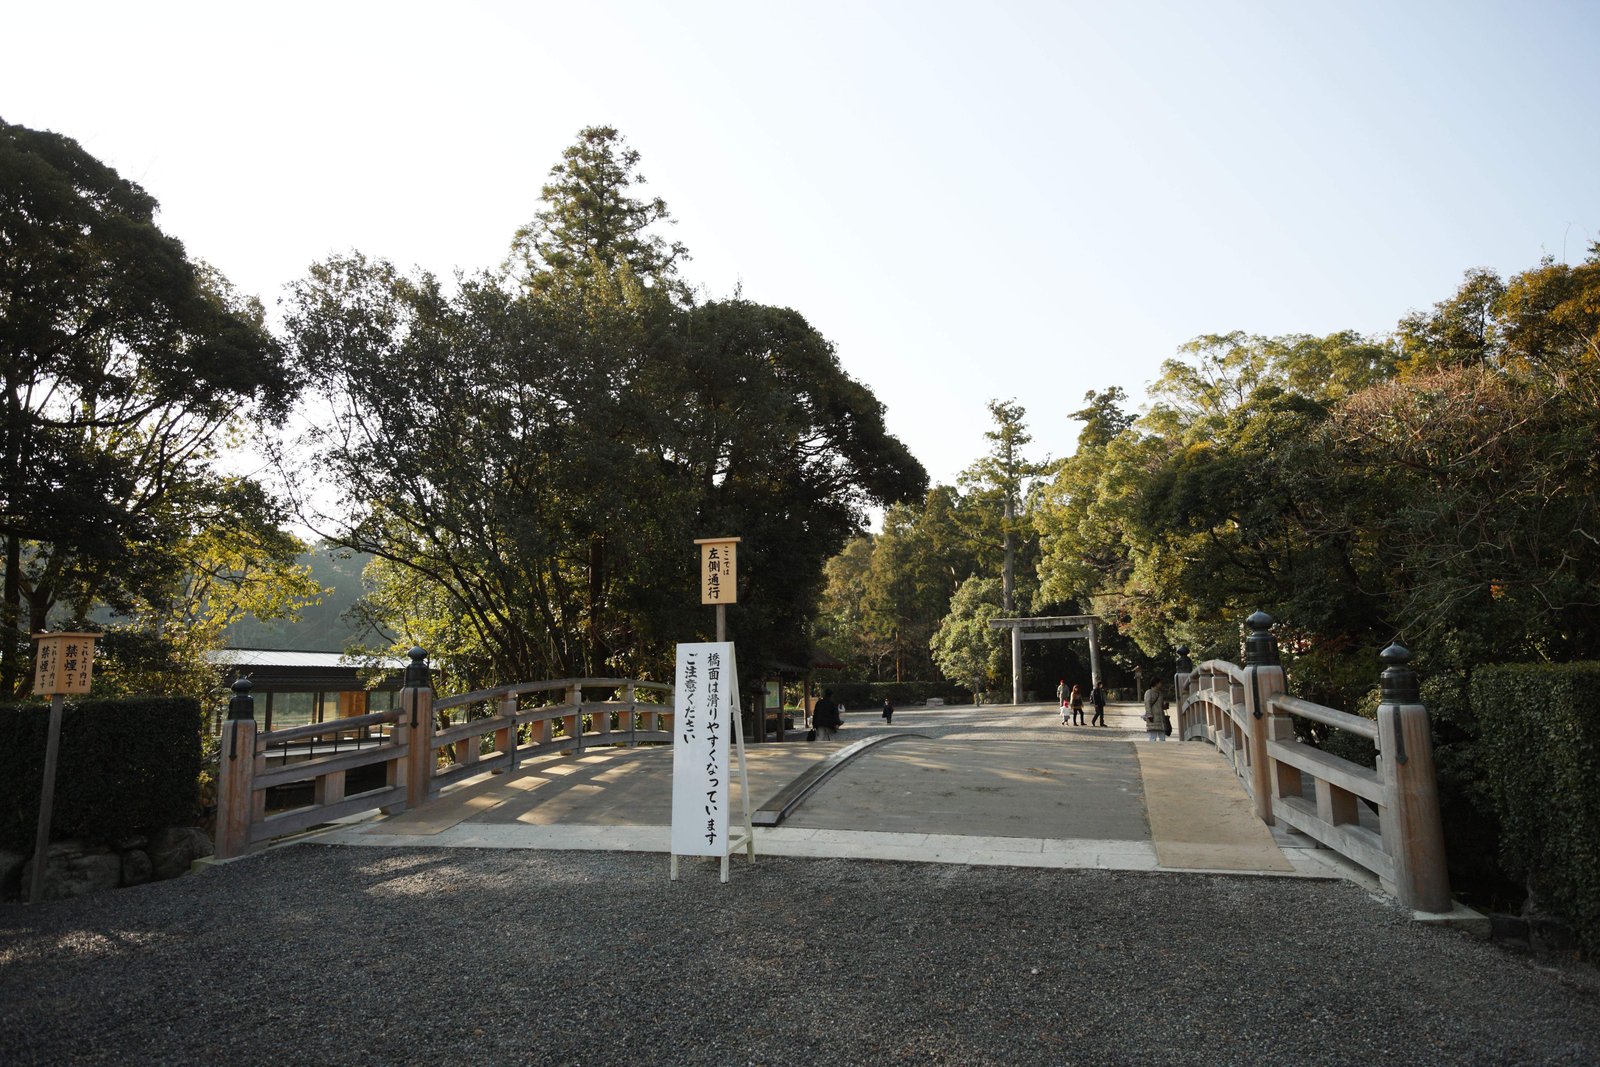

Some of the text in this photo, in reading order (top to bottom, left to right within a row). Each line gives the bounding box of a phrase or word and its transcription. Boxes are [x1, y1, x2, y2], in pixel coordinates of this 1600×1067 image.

[707, 547, 721, 600] 左側通行
[78, 641, 89, 687] これより内は
[683, 652, 698, 744] ご注意ください
[704, 652, 720, 846] 橋面は滑りやすくなっています
